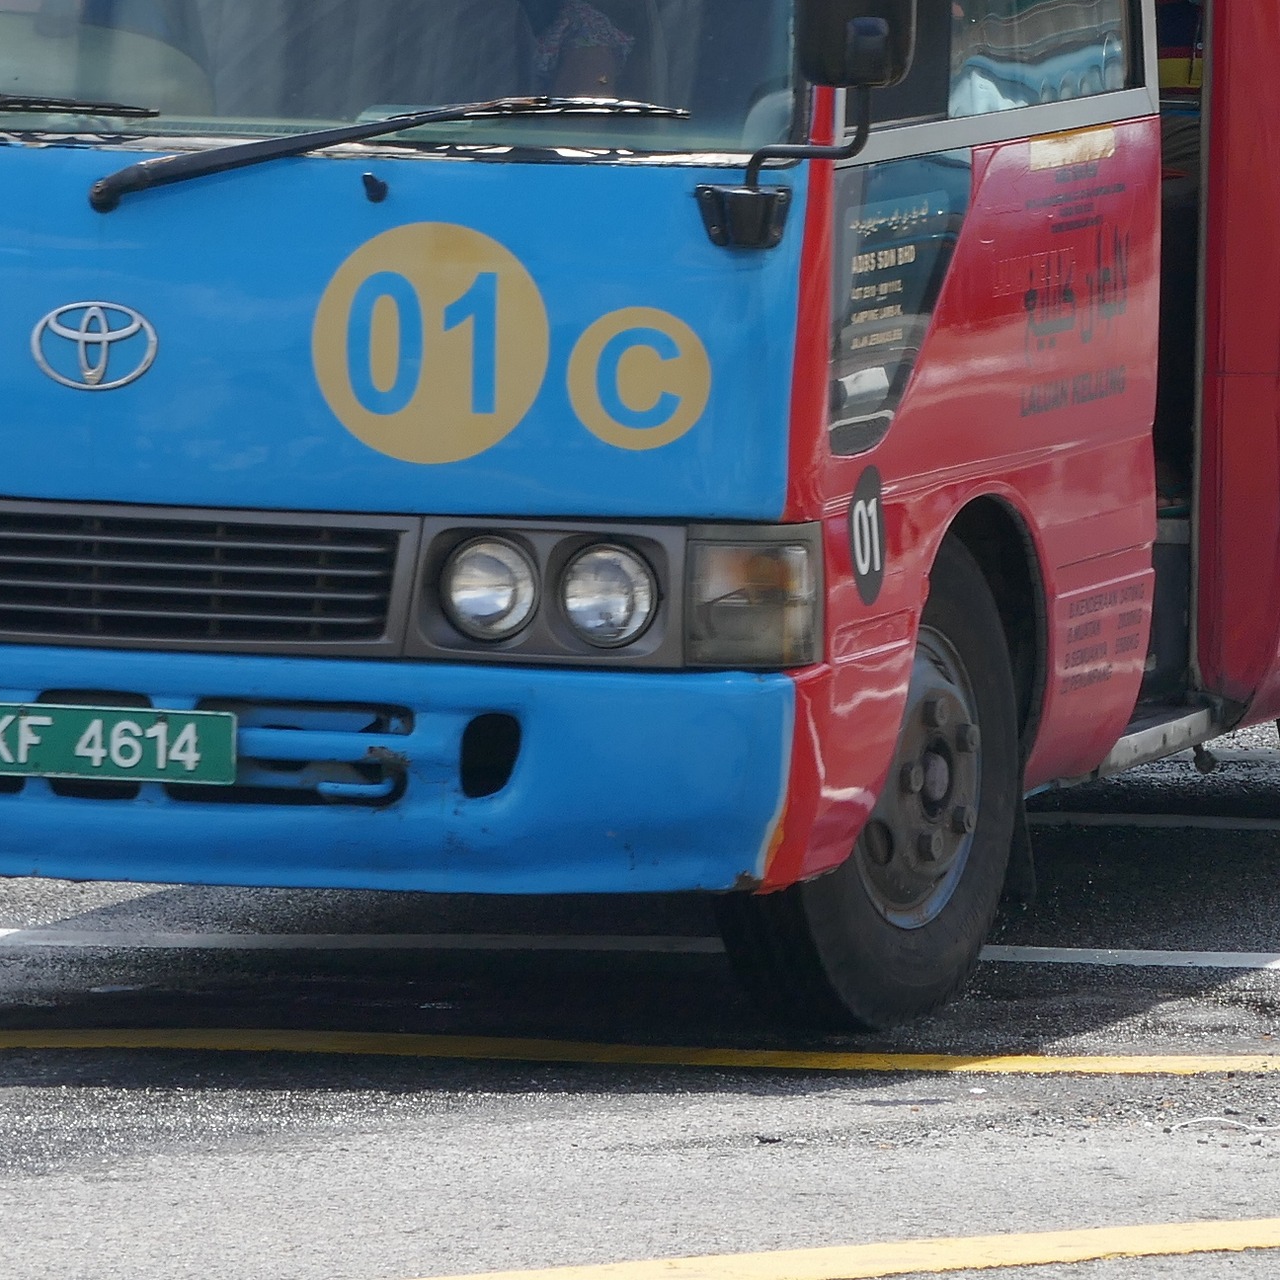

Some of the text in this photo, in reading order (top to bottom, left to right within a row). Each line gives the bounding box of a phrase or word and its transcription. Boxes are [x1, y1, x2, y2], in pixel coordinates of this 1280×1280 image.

[345, 270, 682, 429] 01 C
[853, 497, 881, 576] 01
[74, 718, 202, 771] 4614
